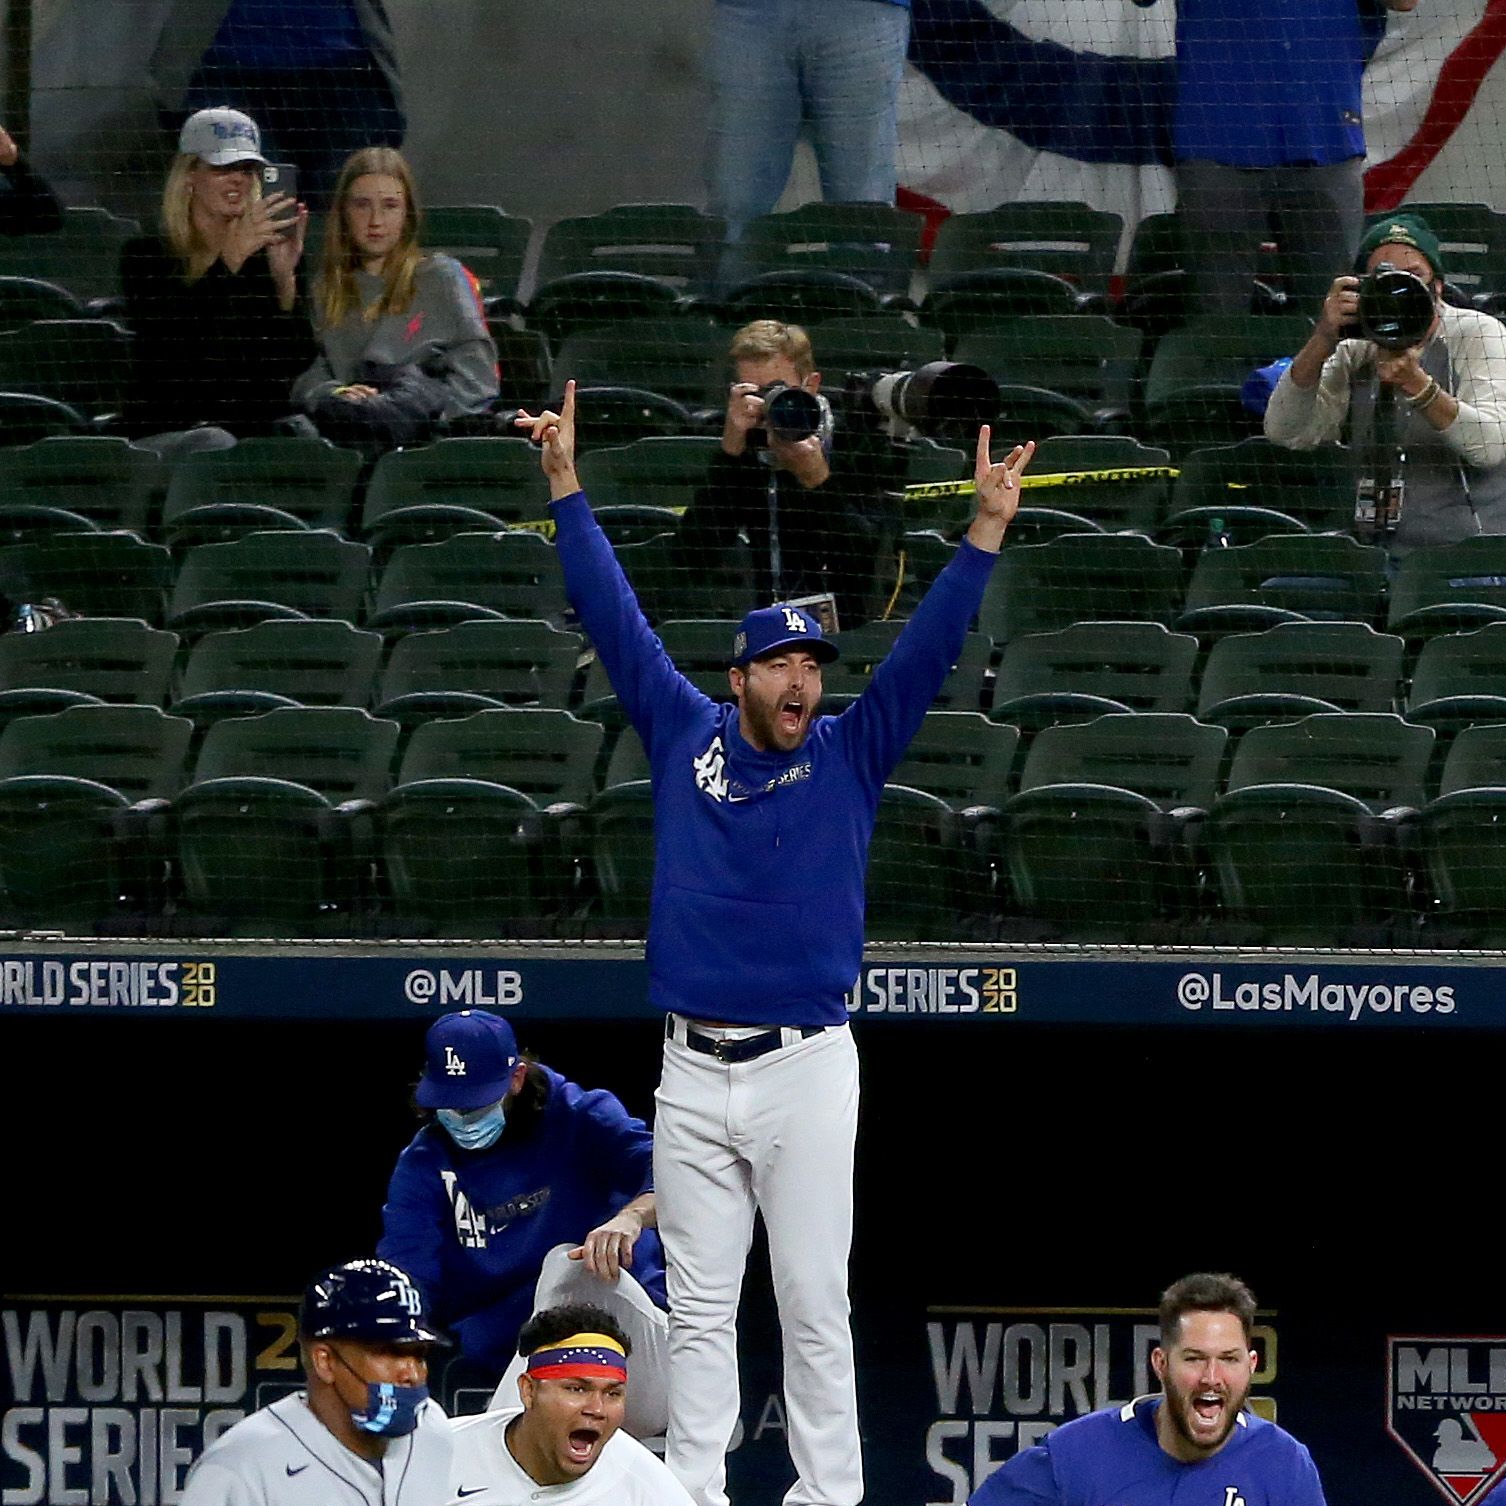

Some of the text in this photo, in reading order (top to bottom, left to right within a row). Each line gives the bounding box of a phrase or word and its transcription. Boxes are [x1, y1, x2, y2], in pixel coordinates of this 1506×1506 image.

[781, 608, 807, 633] LA
[0, 961, 216, 1006] RLD SERIES 20
[181, 985, 216, 1007] 20
[404, 969, 523, 1005] @MLB
[866, 968, 979, 1013] SERIES
[981, 968, 1017, 990] 20
[1177, 972, 1456, 1021] @LasMayores
[981, 991, 1017, 1013] 20
[445, 1047, 466, 1076] LA
[1, 1310, 299, 1404] WORLD 2
